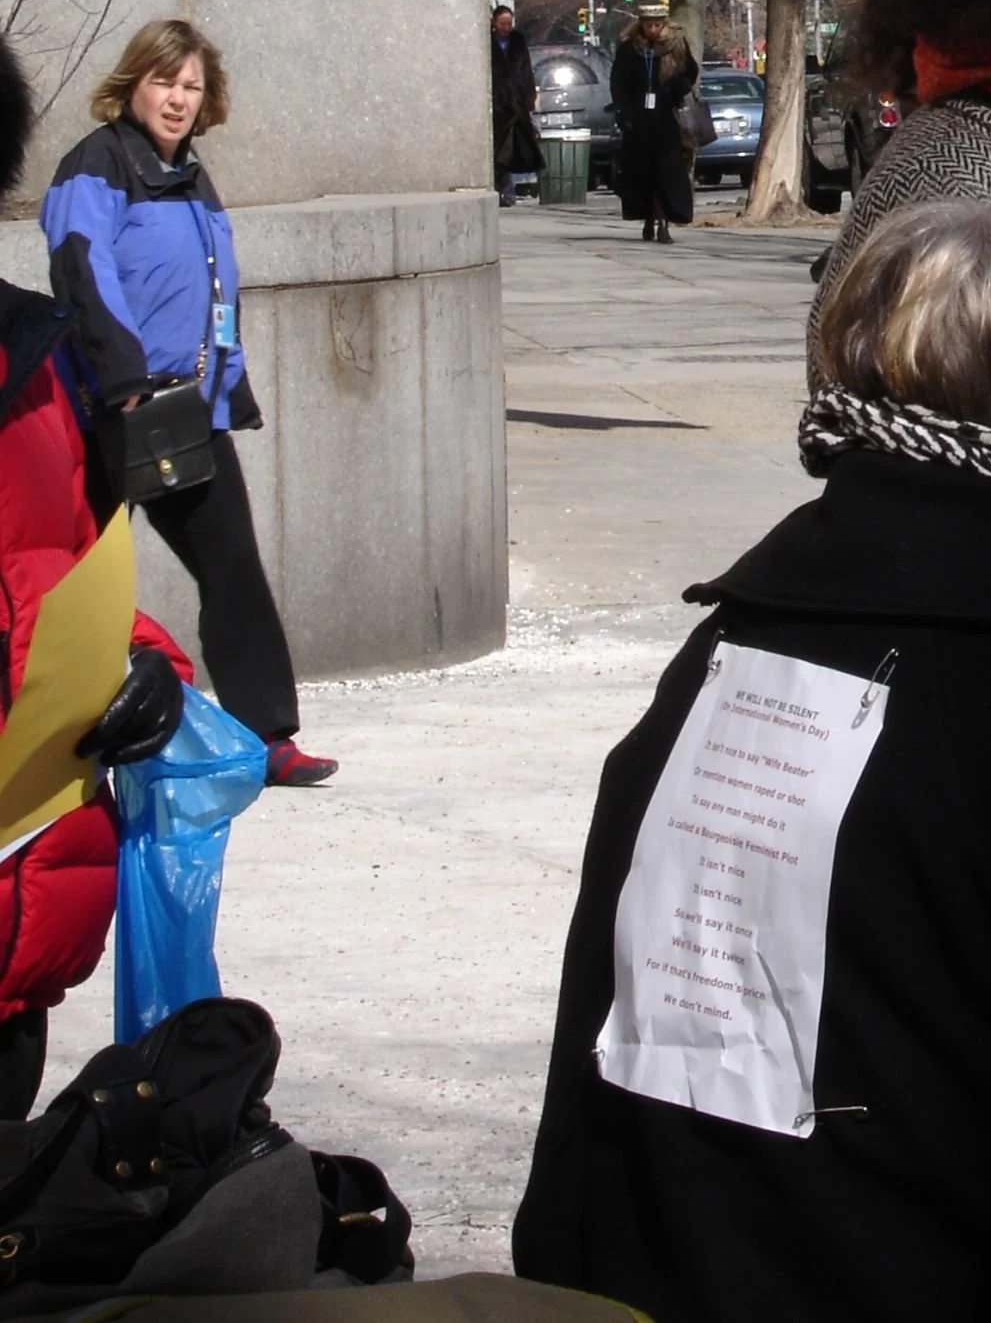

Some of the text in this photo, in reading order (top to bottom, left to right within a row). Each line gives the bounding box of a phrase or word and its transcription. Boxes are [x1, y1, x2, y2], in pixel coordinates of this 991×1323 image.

[764, 697, 778, 710] NOT
[778, 701, 788, 712] BE
[788, 704, 820, 720] SILENT
[772, 715, 806, 733] Women's
[807, 725, 830, 741] Day)
[747, 753, 760, 766] say
[782, 762, 815, 778] Beater"
[727, 778, 753, 791] women
[753, 785, 777, 799] raped
[776, 791, 787, 800] or
[787, 794, 806, 807] shot
[699, 798, 711, 810] say
[711, 802, 725, 814] any
[742, 811, 766, 825] might
[766, 818, 778, 829] do
[778, 819, 786, 832] it
[744, 840, 780, 860] Feminist
[781, 851, 799, 866] Plot
[706, 859, 726, 873] isn't
[727, 865, 745, 879] nice
[700, 886, 722, 901] isn't
[724, 894, 743, 907] nice
[704, 918, 724, 932] say
[725, 921, 734, 933] it
[734, 926, 753, 939] once
[671, 934, 746, 967] We'll say it twice
[646, 958, 661, 970] For
[662, 963, 670, 973] if
[692, 971, 741, 994] freedom's
[741, 985, 767, 1001] price
[664, 992, 733, 1021] We don't mind.
